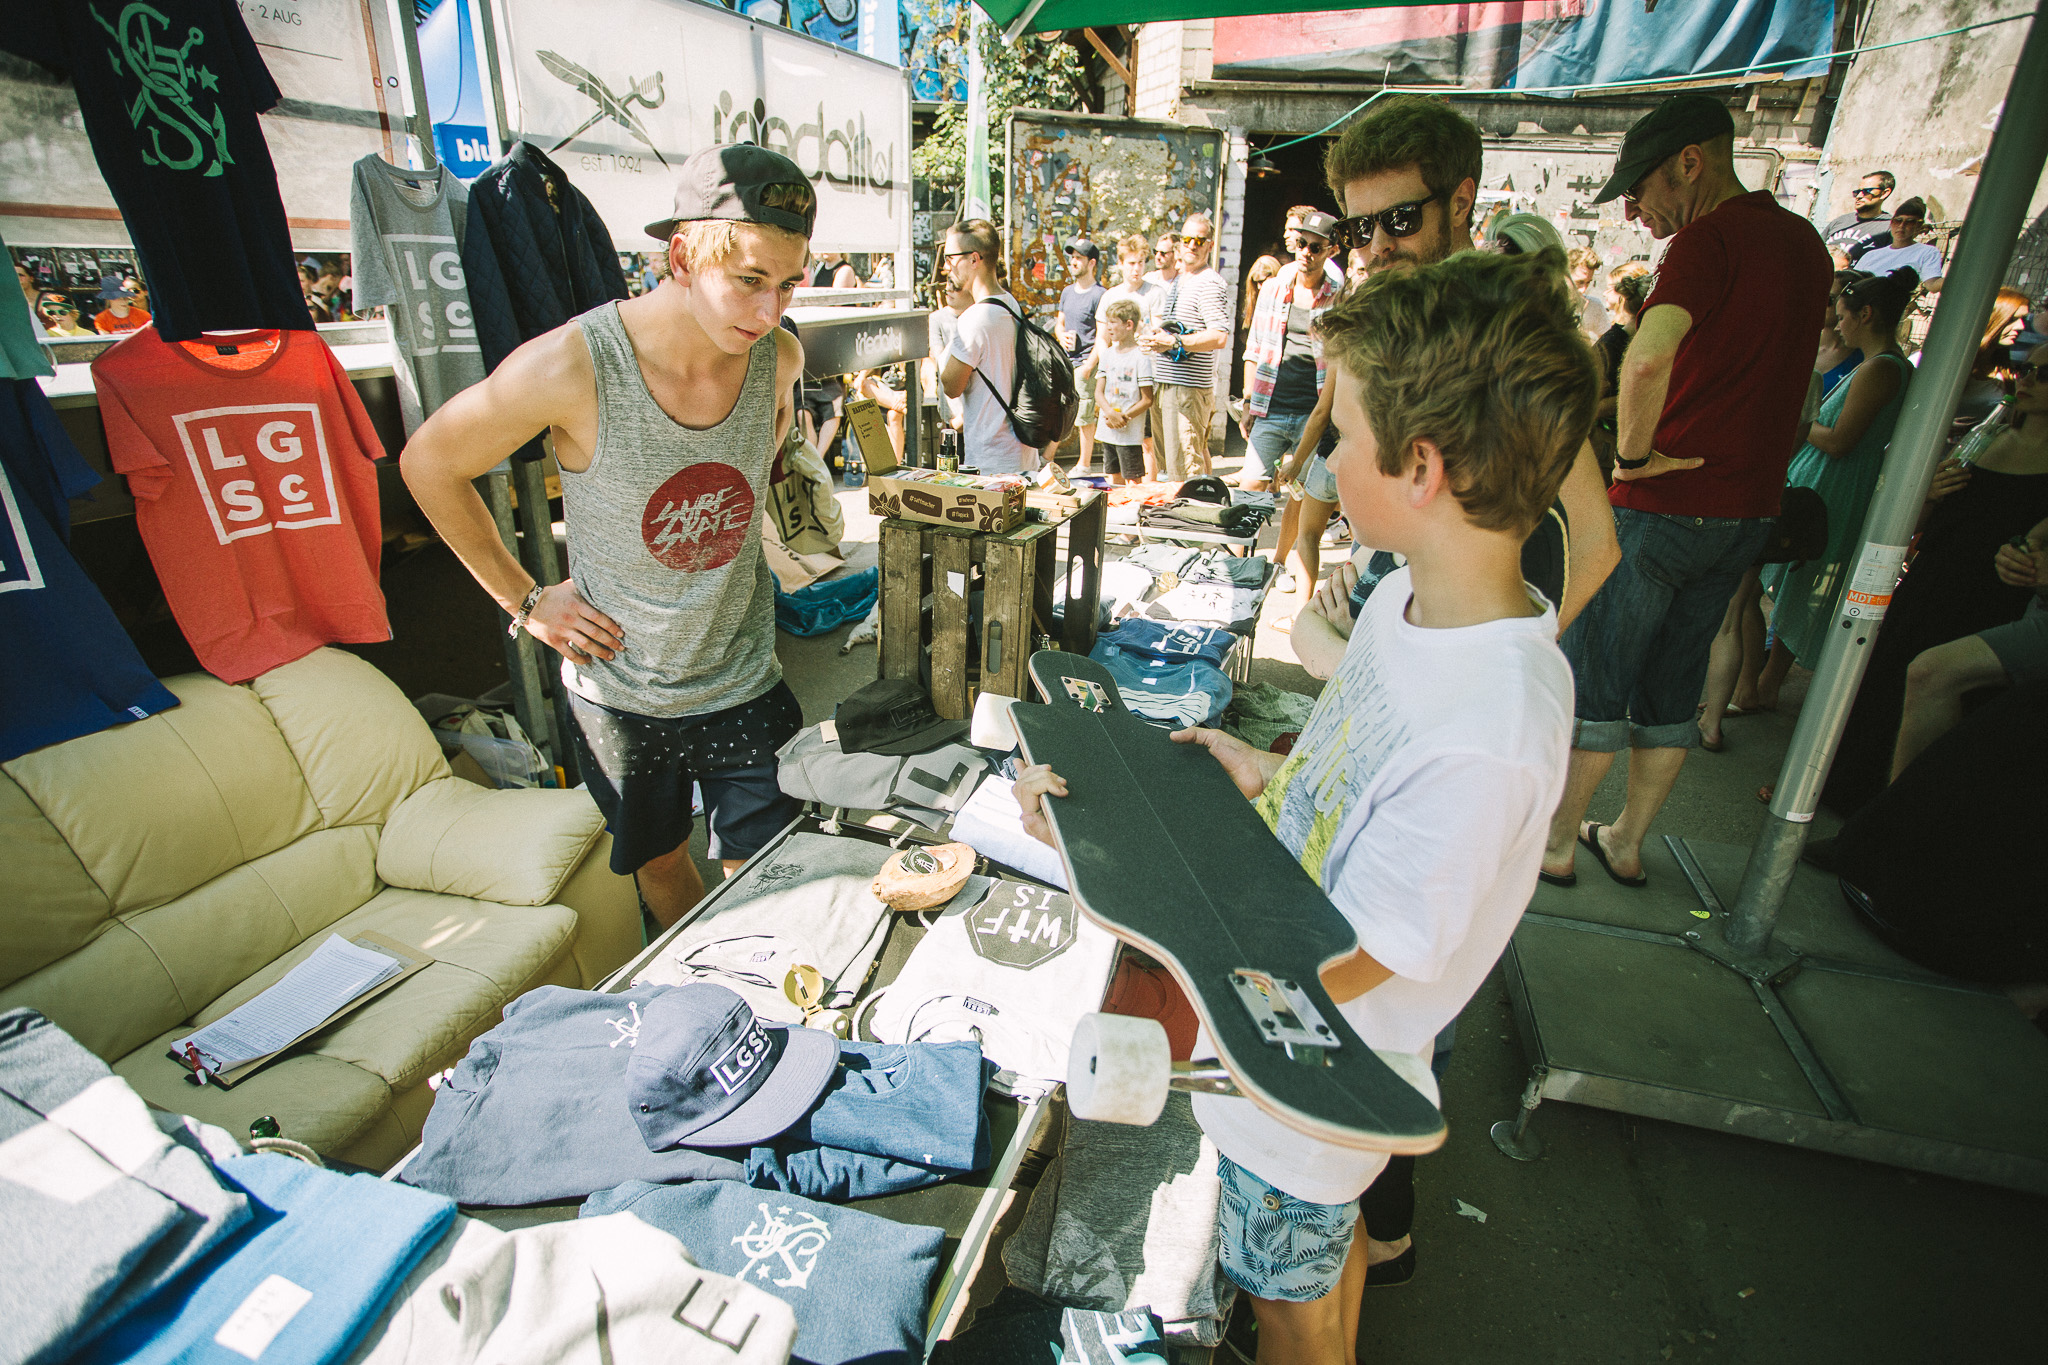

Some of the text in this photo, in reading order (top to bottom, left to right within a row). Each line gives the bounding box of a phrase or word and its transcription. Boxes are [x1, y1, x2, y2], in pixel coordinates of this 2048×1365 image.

[259, 5, 269, 19] 2
[273, 9, 302, 26] AUG
[581, 153, 642, 174] est. 1994
[650, 485, 743, 525] SURF
[650, 502, 750, 557] SKATE
